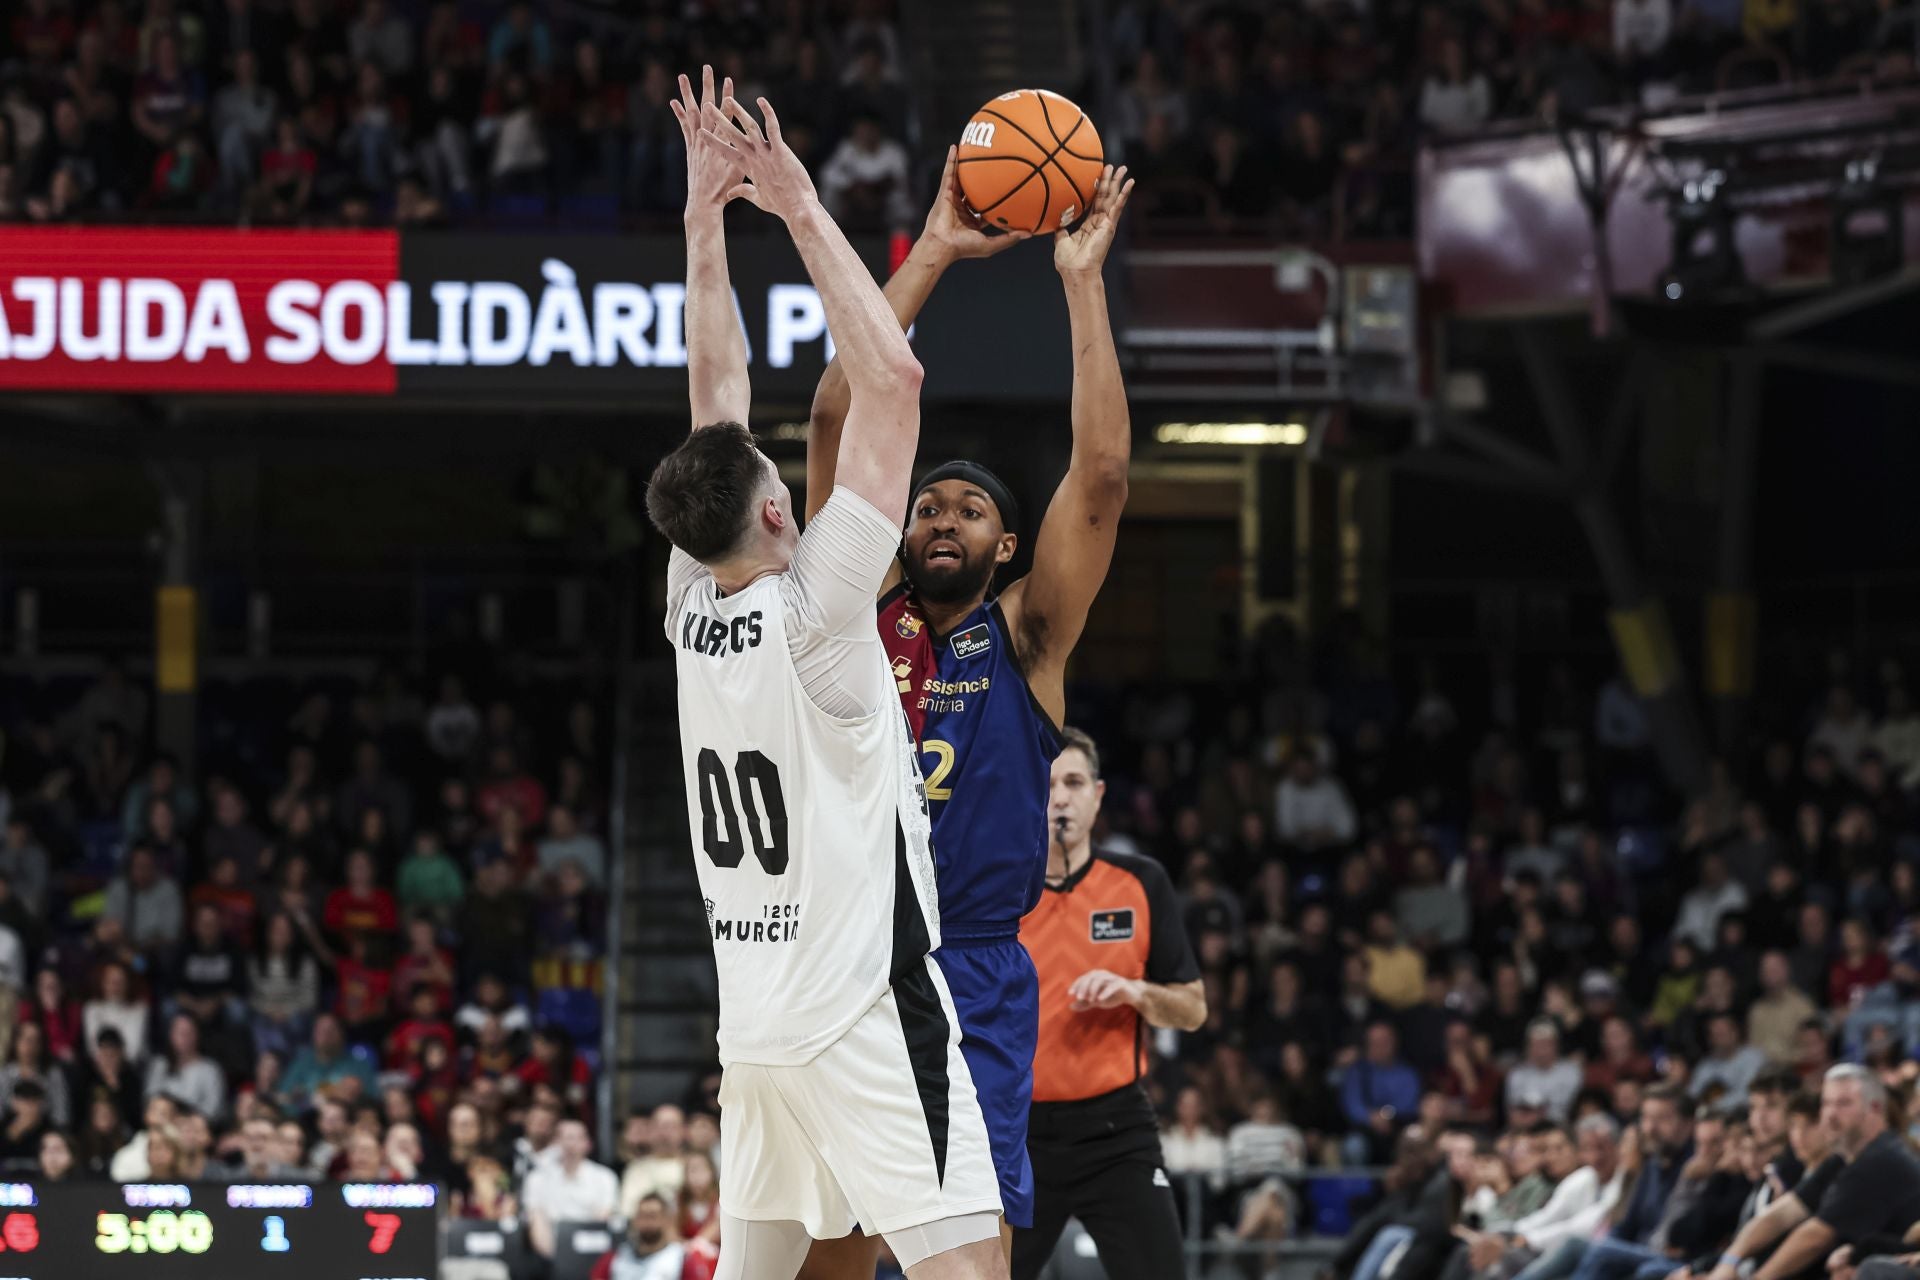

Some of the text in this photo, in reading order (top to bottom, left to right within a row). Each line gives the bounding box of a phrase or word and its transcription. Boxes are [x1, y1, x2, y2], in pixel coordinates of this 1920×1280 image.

[264, 258, 752, 367] SOLIDÀRI
[956, 639, 971, 650] liga
[958, 638, 990, 655] endesa
[921, 739, 955, 801] 2
[697, 747, 789, 876] 00
[0, 1211, 39, 1253] 6
[95, 1209, 214, 1254] 5:00
[261, 1215, 290, 1252] 1
[364, 1210, 401, 1254] 7
